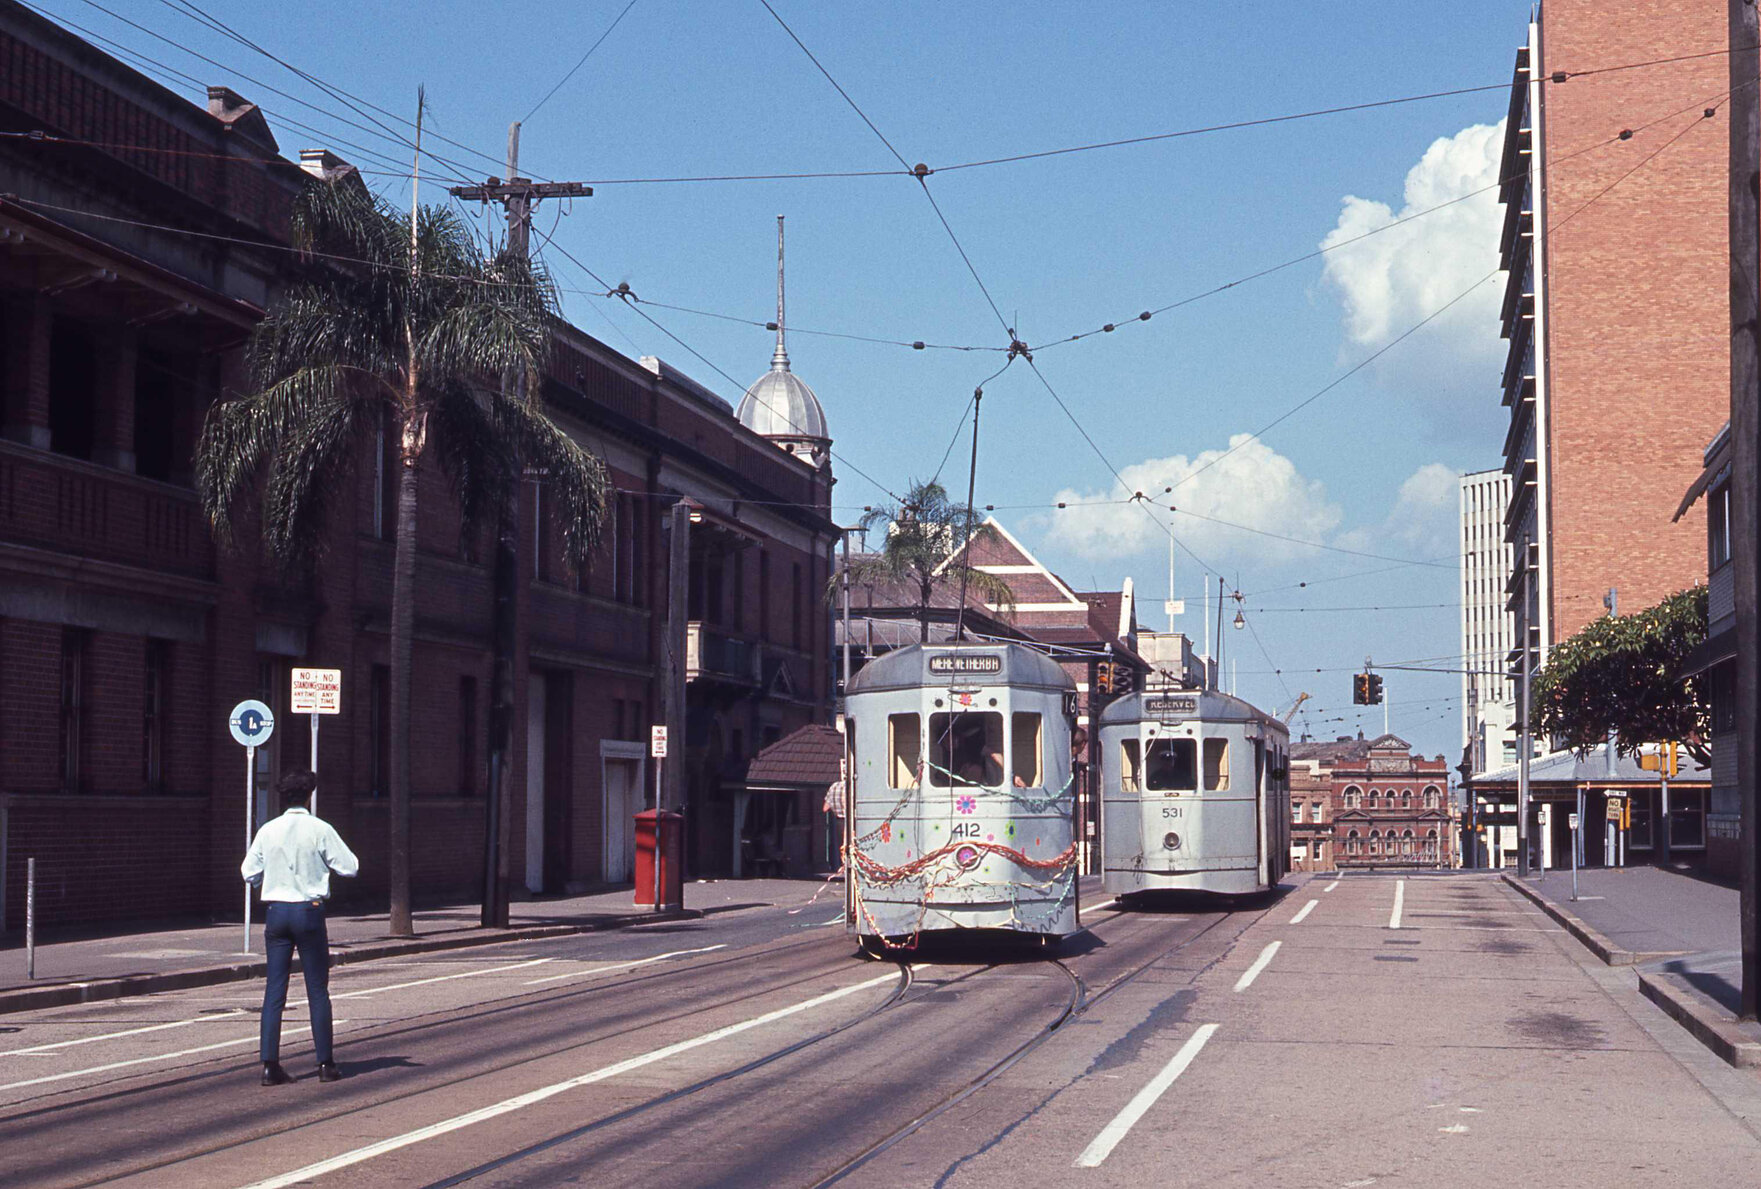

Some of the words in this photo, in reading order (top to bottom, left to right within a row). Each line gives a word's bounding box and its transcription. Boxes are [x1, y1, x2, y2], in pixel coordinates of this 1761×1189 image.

[300, 672, 311, 680] NO
[323, 674, 334, 682] NO
[294, 681, 317, 690] STANDING
[317, 683, 339, 692] STANDING
[1065, 695, 1076, 713] 16
[1162, 808, 1182, 818] 531
[952, 823, 981, 837] 412
